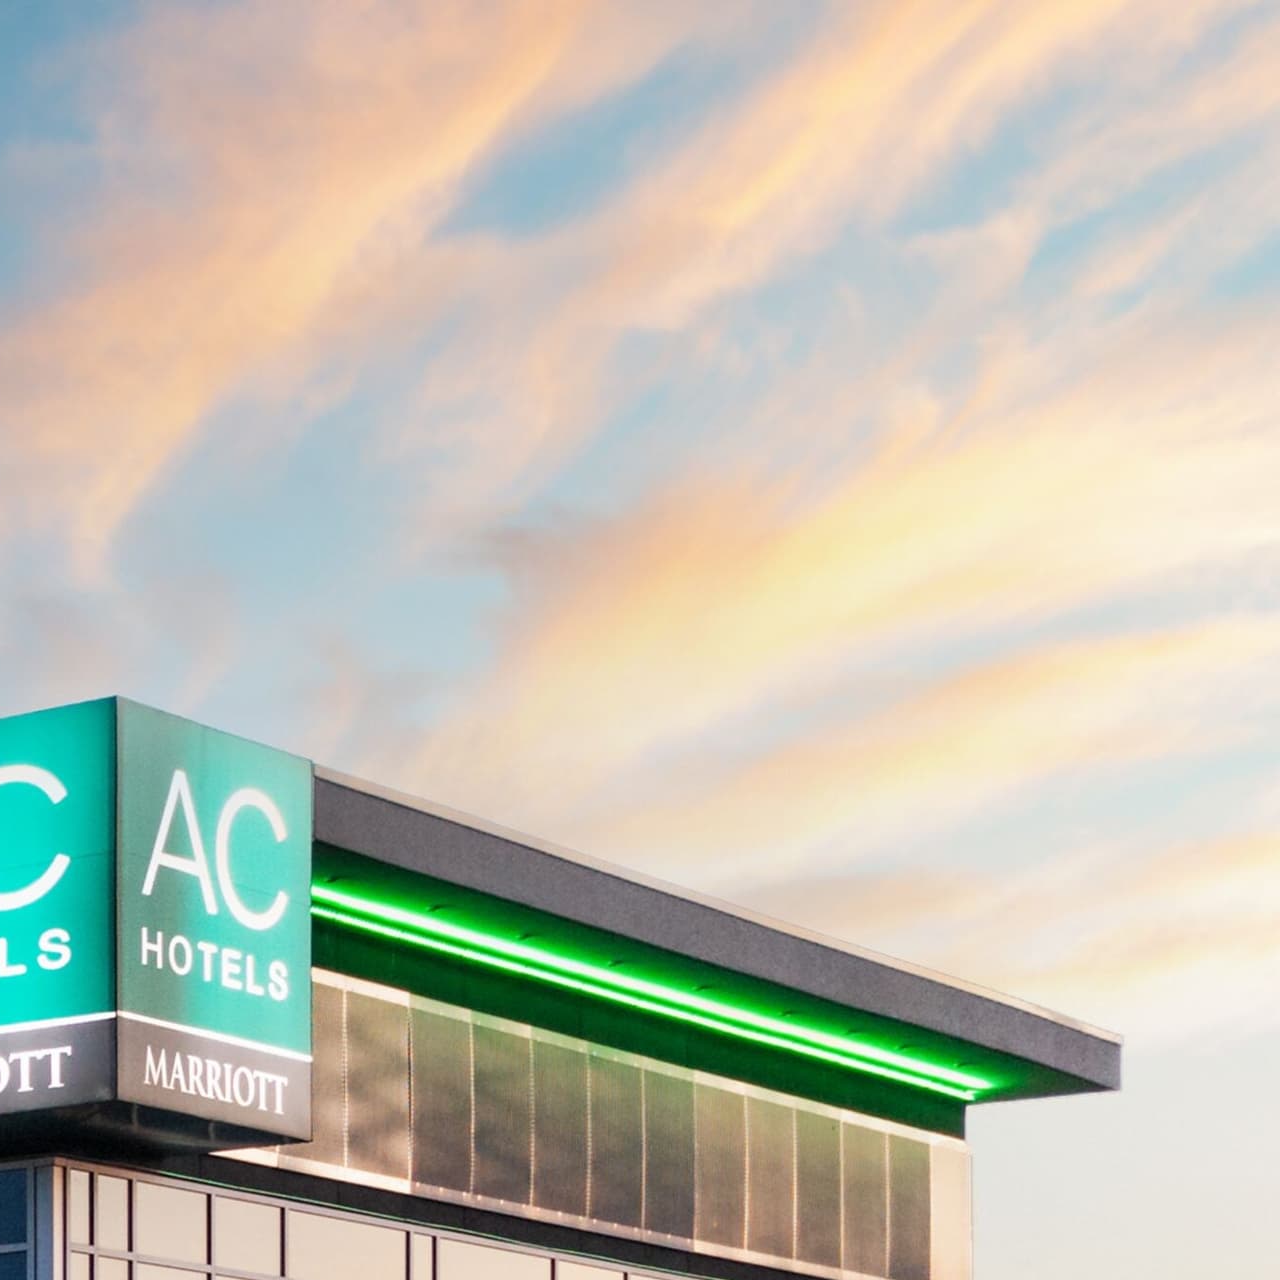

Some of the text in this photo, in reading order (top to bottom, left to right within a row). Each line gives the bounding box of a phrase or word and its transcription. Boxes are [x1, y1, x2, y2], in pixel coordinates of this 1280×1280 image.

[142, 769, 289, 931] AC
[141, 926, 288, 1001] HOTELS
[143, 1045, 289, 1115] MARRIOTT
